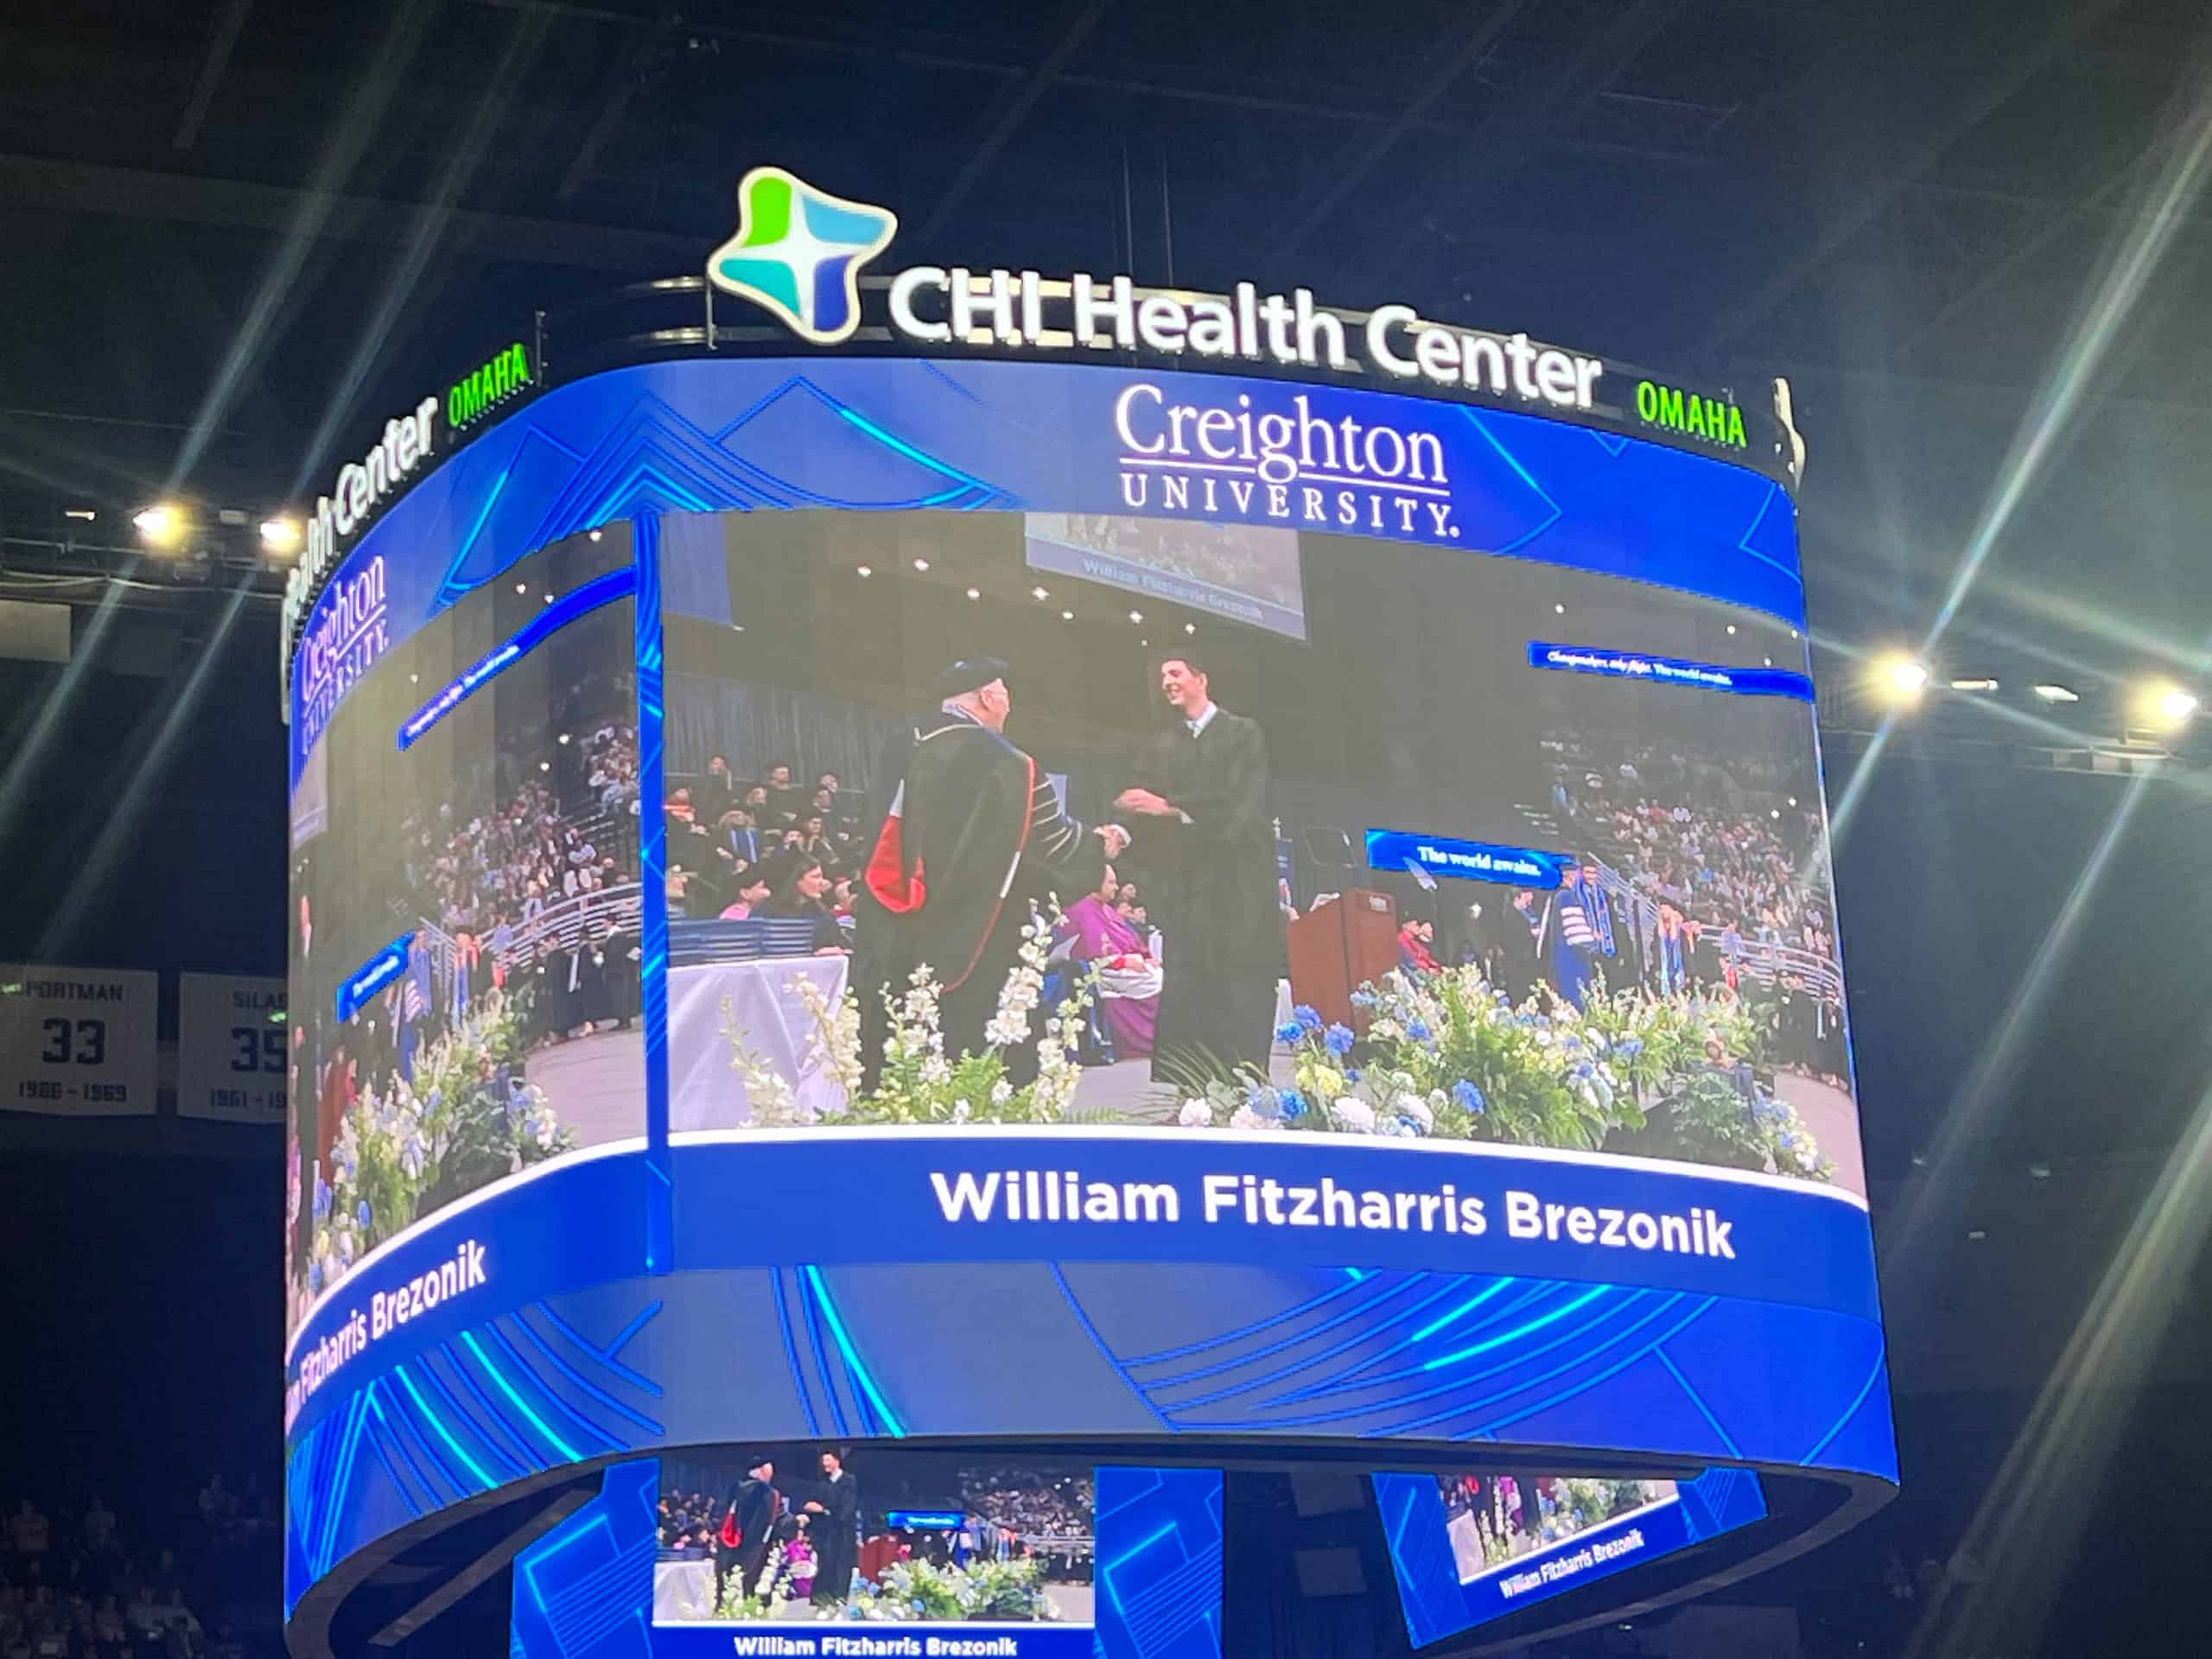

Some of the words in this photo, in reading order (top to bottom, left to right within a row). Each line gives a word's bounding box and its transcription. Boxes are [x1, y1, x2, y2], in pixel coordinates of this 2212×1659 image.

[888, 265, 1041, 346] CHI
[1072, 272, 1345, 367] Health
[1365, 305, 1602, 409] Center
[448, 343, 531, 428] OMAHA
[1637, 380, 1747, 448] OMAHA
[335, 396, 438, 535] Center
[1115, 383, 1449, 485] Creighton
[1417, 846, 1447, 863] The
[1448, 853, 1491, 869] world
[43, 1017, 105, 1065] 33
[930, 1172, 1179, 1223] William
[1204, 1174, 1487, 1236] Fitzharris
[1503, 1190, 1736, 1259] Brezonik
[372, 1239, 486, 1340] Brezonik
[1592, 1529, 1645, 1564] Brezonik
[734, 1636, 815, 1656] William
[822, 1636, 921, 1656] Fitzharris
[925, 1637, 1017, 1656] Brezonik
